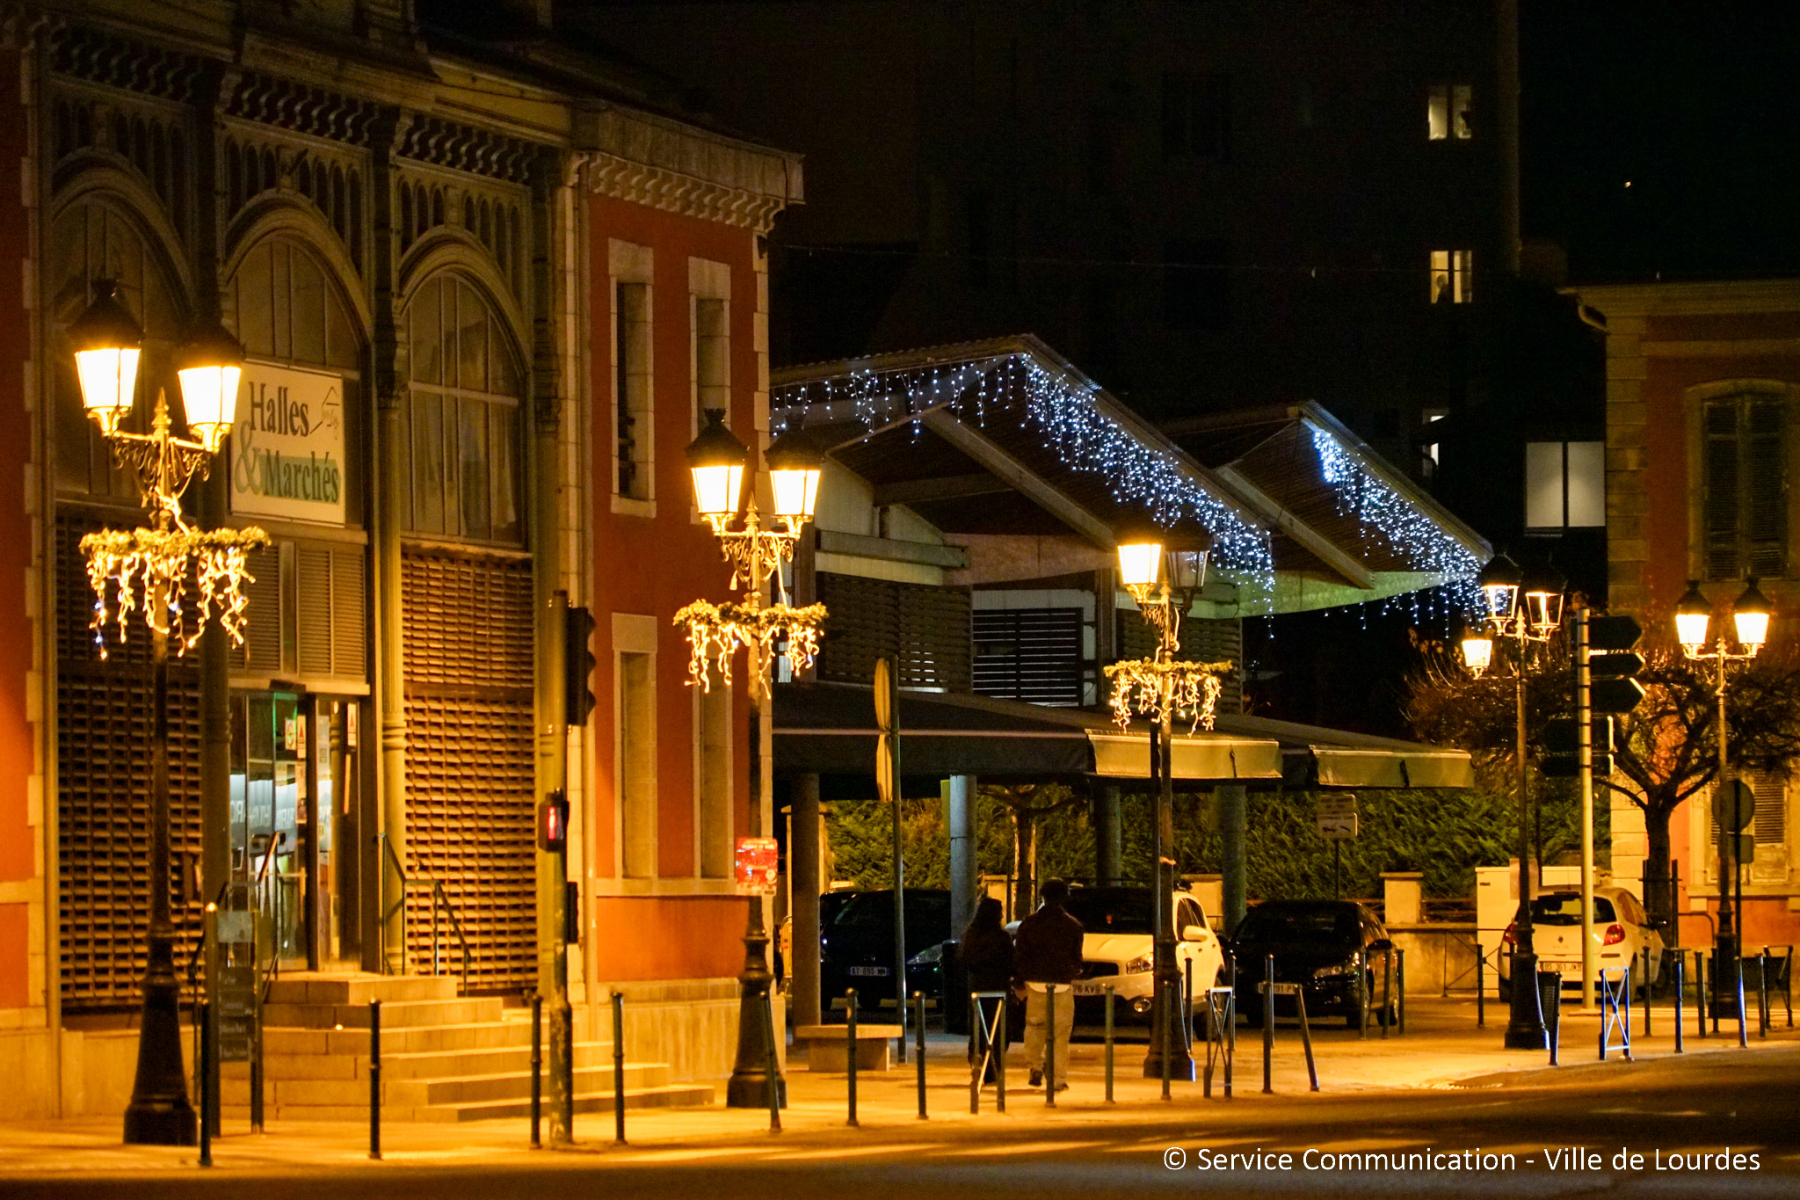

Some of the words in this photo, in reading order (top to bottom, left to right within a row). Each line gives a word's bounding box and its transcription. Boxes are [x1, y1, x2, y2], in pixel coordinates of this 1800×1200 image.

[249, 381, 309, 437] Halles
[235, 420, 261, 495] &
[264, 448, 339, 503] Marchés
